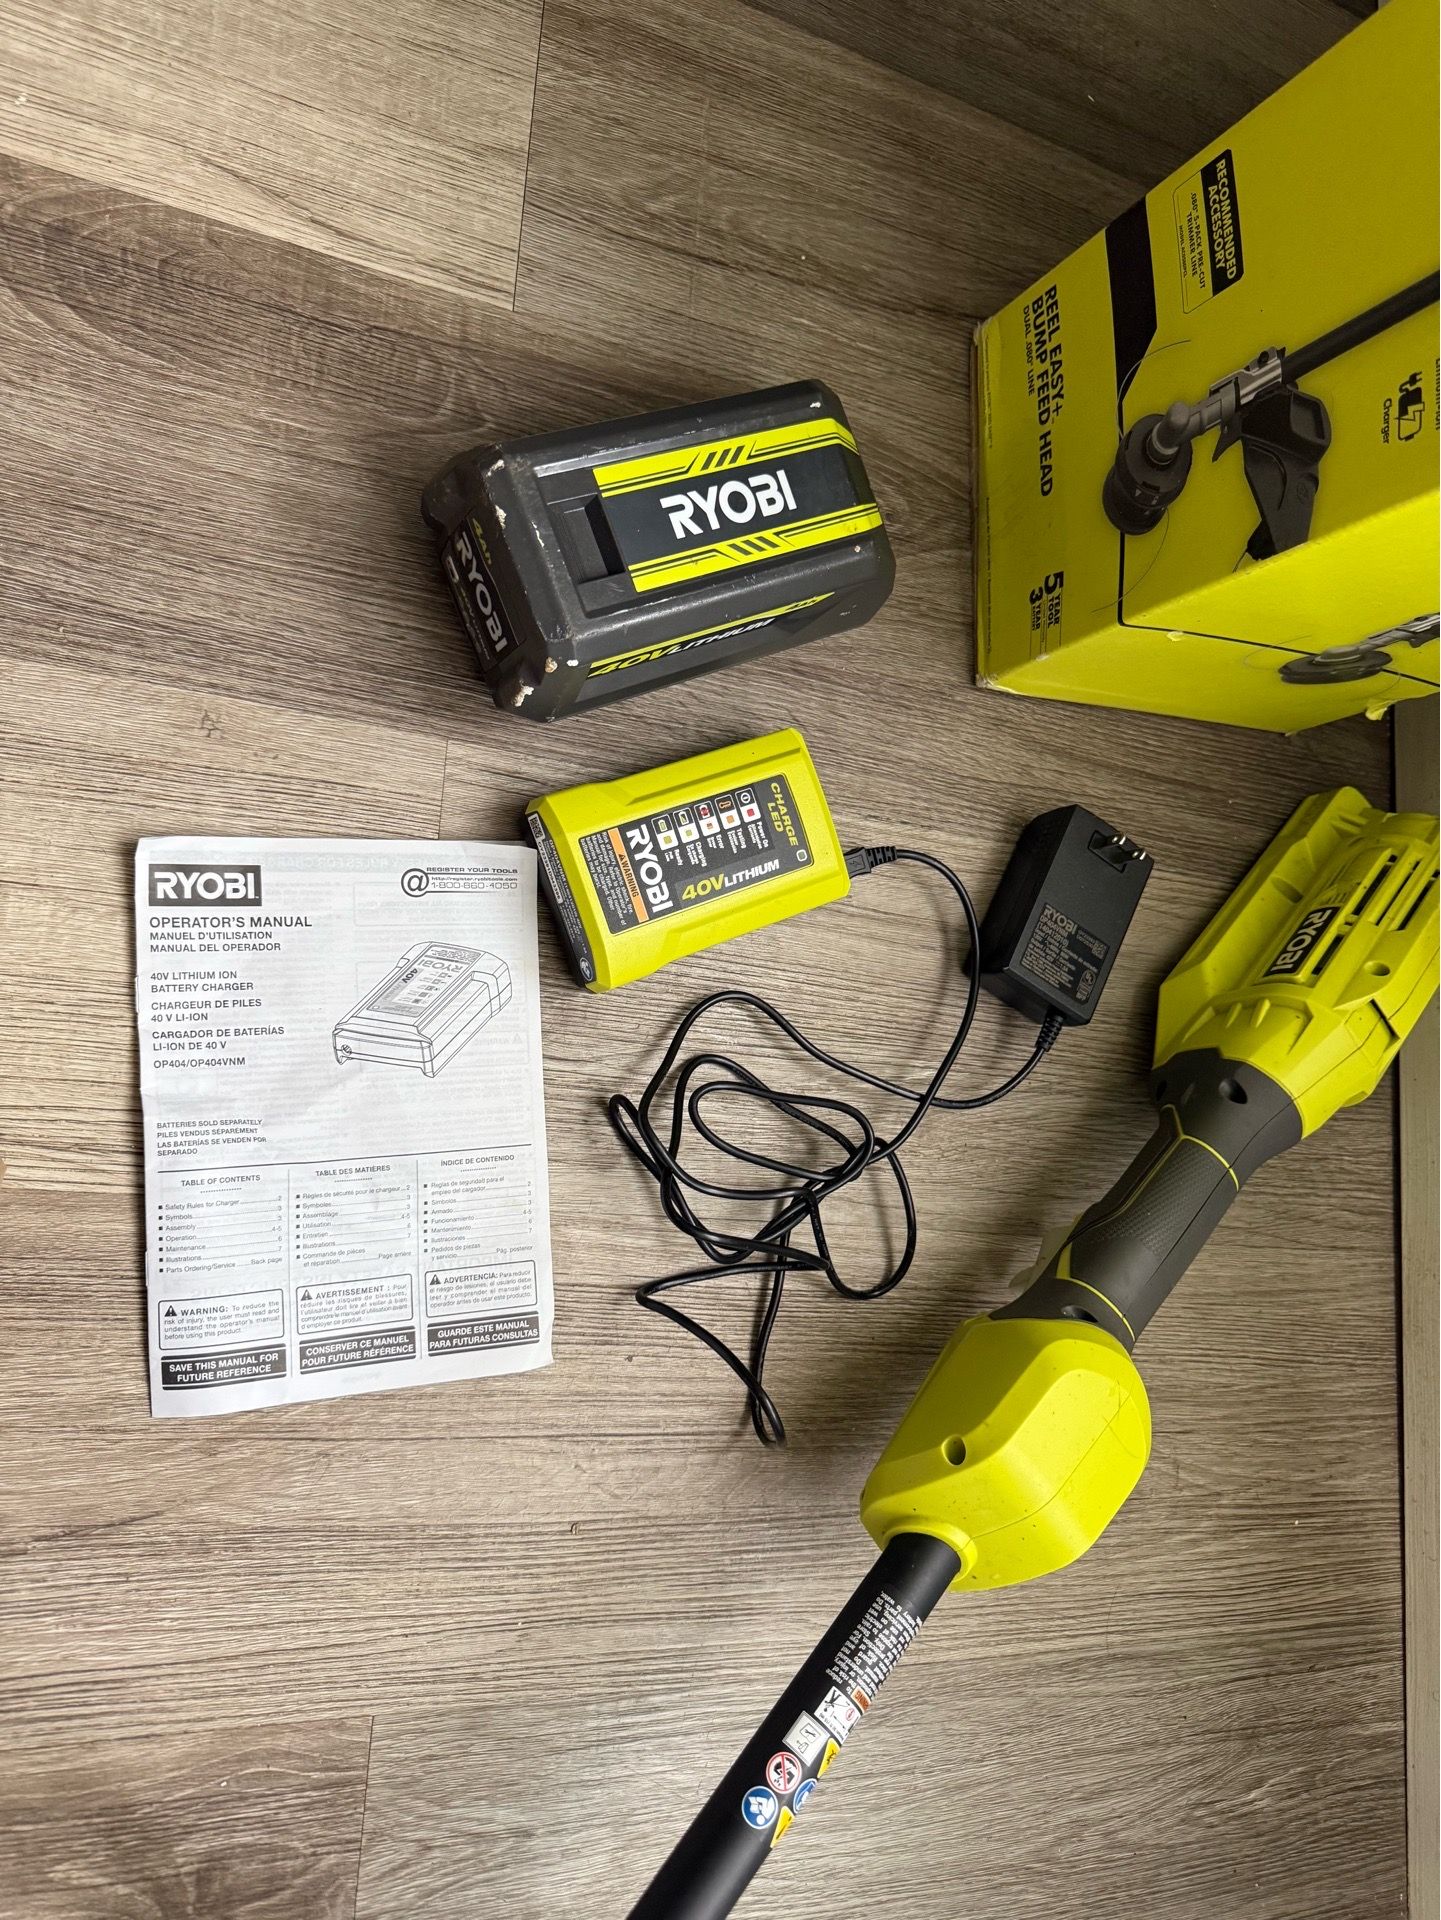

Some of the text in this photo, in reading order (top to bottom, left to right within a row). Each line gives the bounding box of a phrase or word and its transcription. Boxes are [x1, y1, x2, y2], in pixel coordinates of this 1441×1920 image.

[1208, 185, 1225, 269] ACCESSORY
[1216, 159, 1236, 280] RECOMMENDED
[1187, 212, 1195, 253] TRIMMER
[1193, 215, 1201, 247] 5-PACK
[1197, 250, 1205, 289] PRE-CUT
[1045, 284, 1064, 416] REEL EASY+
[1032, 295, 1053, 496] BUMP FEED HEAD
[1381, 398, 1392, 444] Charger
[659, 468, 797, 540] RYOBI
[456, 531, 508, 652] RYOBI
[1045, 571, 1064, 594] 5
[1030, 587, 1043, 604] 3
[767, 808, 783, 834] LED
[770, 782, 798, 847] CHARGE
[715, 834, 724, 848] Error
[736, 827, 746, 848] Testing
[756, 821, 768, 847] Power On
[674, 848, 682, 865] Ready
[695, 841, 706, 866] Charging
[625, 823, 674, 913] RYOBI
[154, 872, 255, 900] RYOBI
[621, 860, 638, 897] WARNING
[150, 916, 312, 928] OPERATOR'S MANUAL
[1044, 904, 1078, 934] RYOBI
[222, 943, 281, 951] OPERADOR
[1273, 908, 1333, 973] RYOBI
[172, 971, 216, 980] LITHIUM
[219, 971, 237, 979] ION
[151, 983, 254, 992] BATTERY CHARGER
[151, 1001, 212, 1010] CHARGEUR
[232, 999, 262, 1007] PILES
[176, 1013, 208, 1021] LI-ION
[152, 1030, 213, 1039] CARGADOR
[234, 1025, 284, 1036] BATERÍAS
[153, 1043, 185, 1051] LI-ION
[154, 1057, 246, 1068] OP404/OP404VNM
[174, 1139, 209, 1147] BATERÍAS
[476, 1155, 514, 1163] CONTENIDO
[220, 1175, 260, 1183] CONTENTS
[184, 1262, 235, 1272] Ordering/Service
[444, 1273, 498, 1284] ADVERTENCIA:
[316, 1285, 384, 1299] AVERTISSEMENT
[181, 1306, 228, 1316] WARNING:
[430, 1329, 538, 1349] PARA FUTURAS CONSULTAS
[438, 1320, 529, 1338] GUARDE ESTE MANUAL
[302, 1344, 414, 1367] POUR FUTURE RÉFÉRENCE
[306, 1335, 409, 1356] CONSERVER CE MANUEL
[195, 1362, 216, 1370] THIS
[218, 1355, 258, 1367] MANUAL
[177, 1364, 271, 1382] FUTURE REFERENCE
